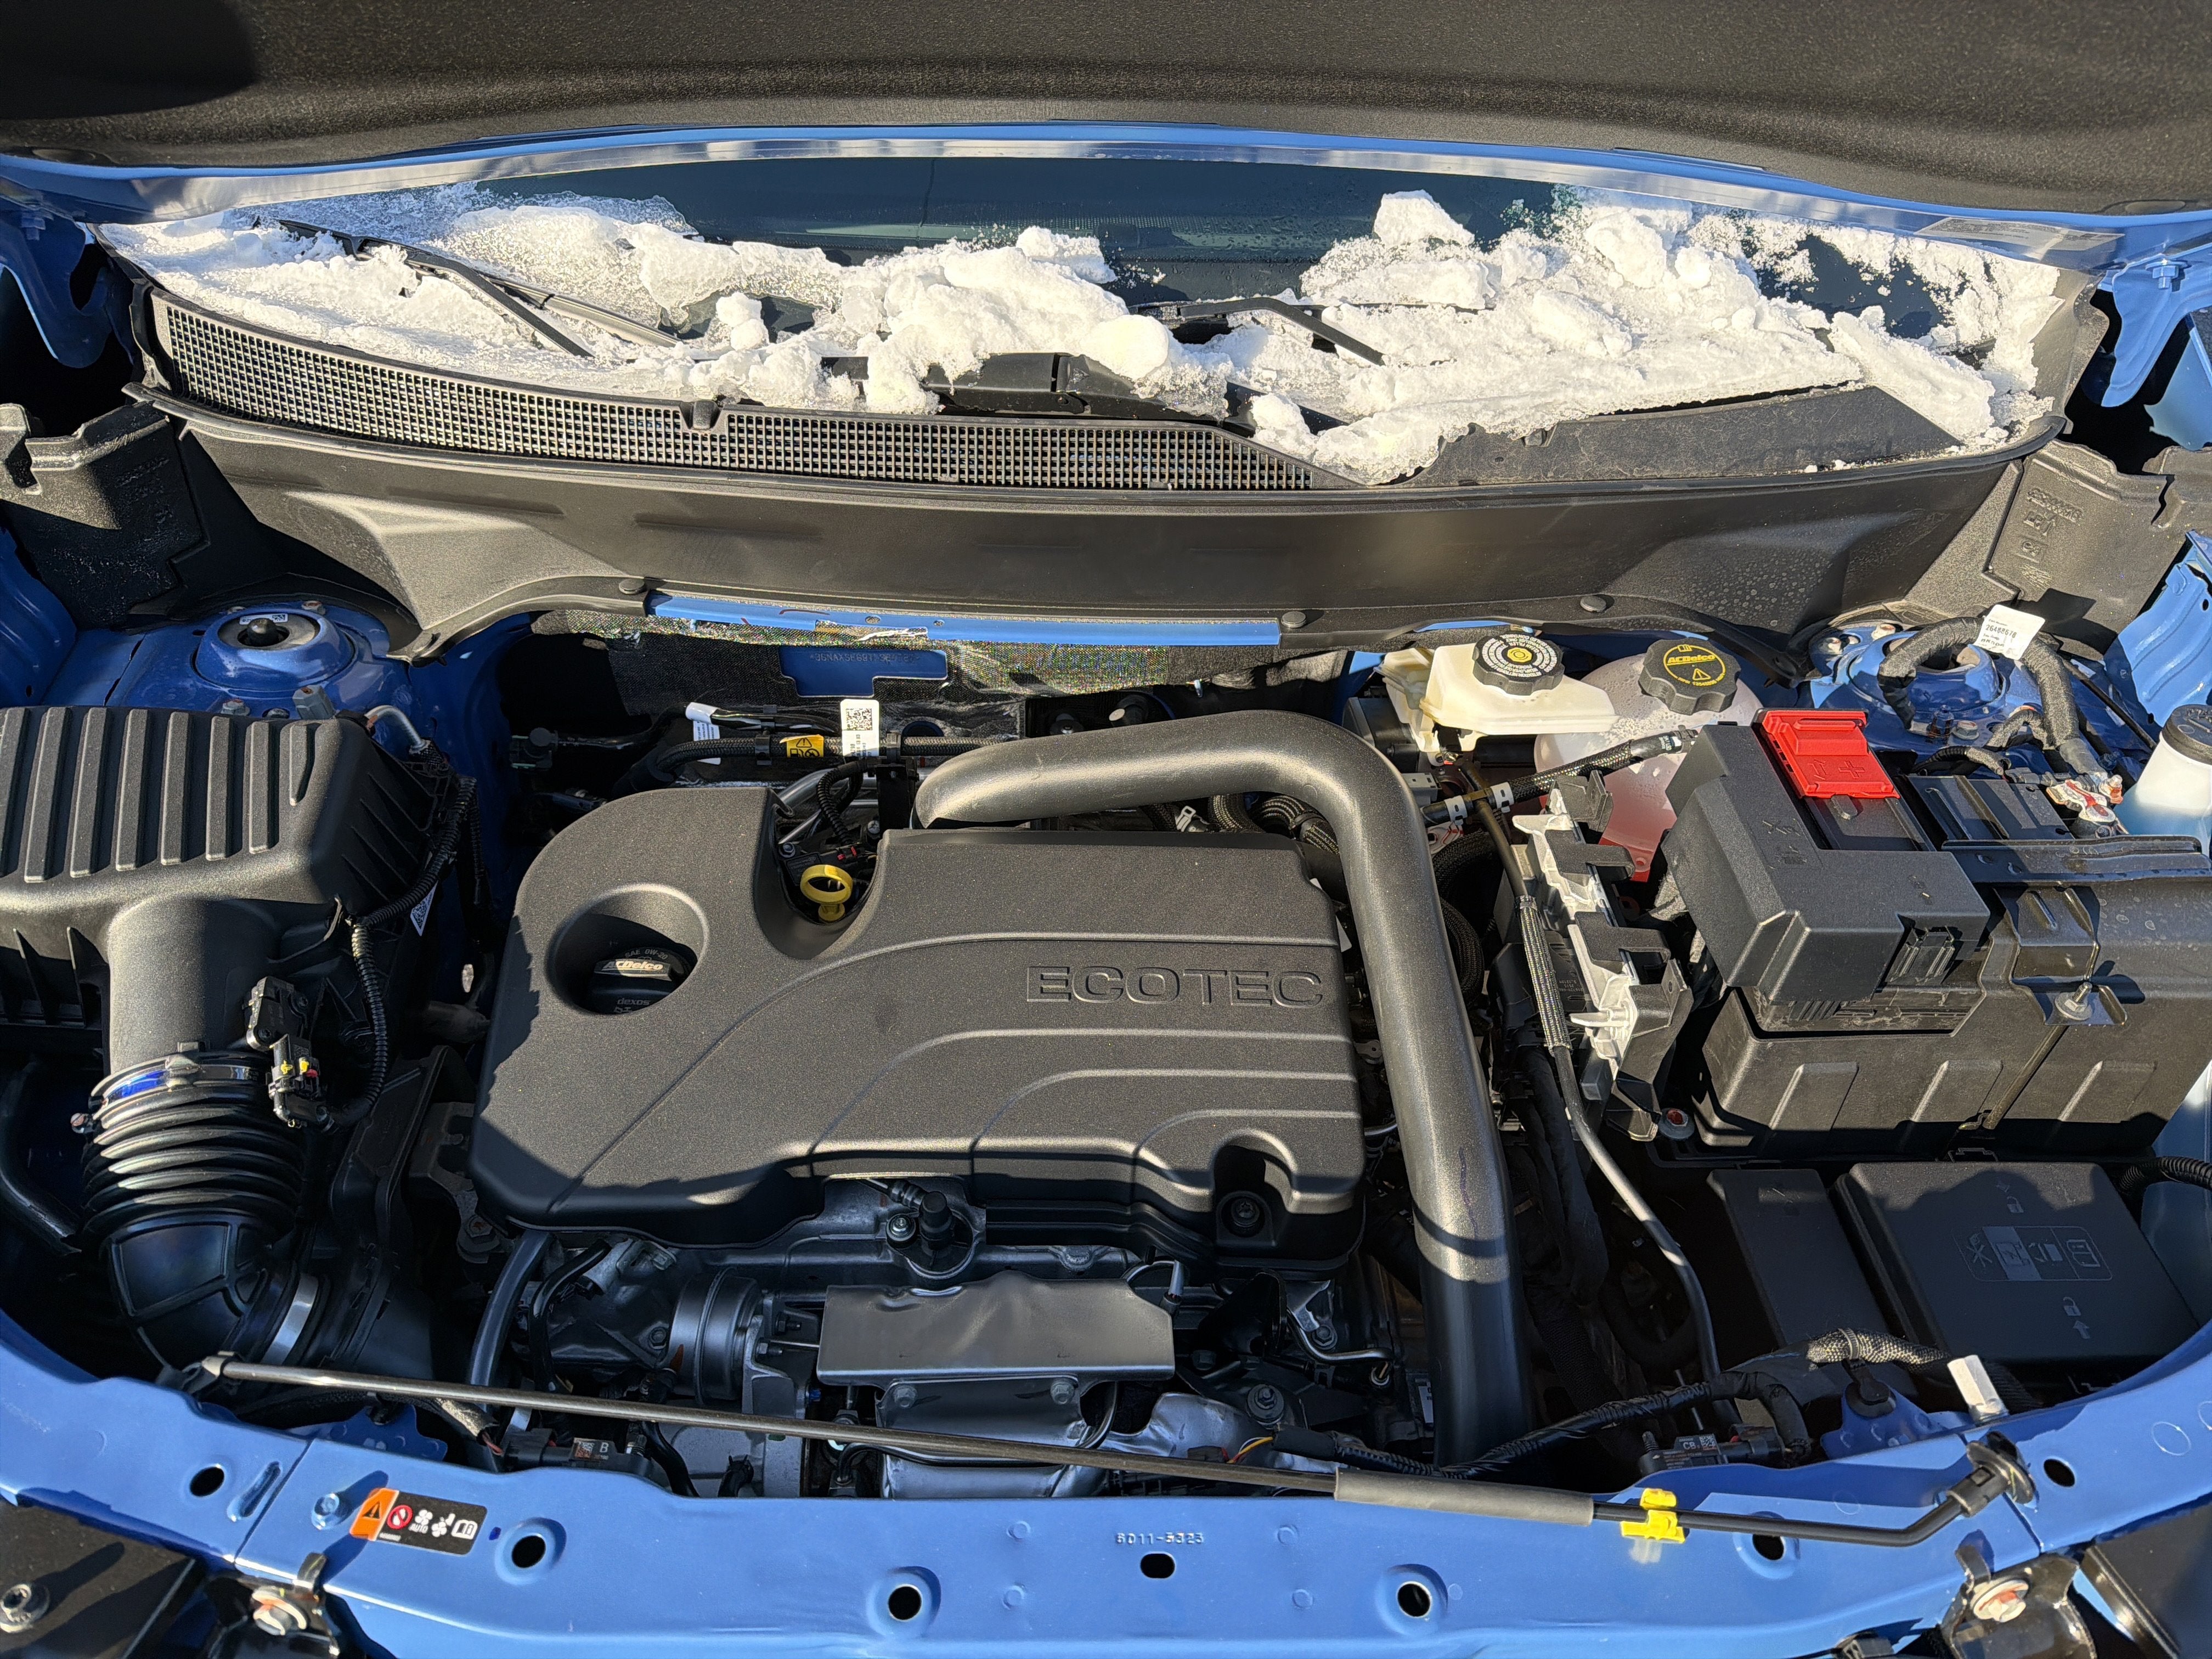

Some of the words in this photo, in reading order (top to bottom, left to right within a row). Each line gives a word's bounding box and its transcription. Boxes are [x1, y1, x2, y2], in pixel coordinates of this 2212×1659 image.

[1668, 654, 1716, 663] ACDelco
[625, 949, 641, 958] SAE
[645, 949, 669, 960] 0W-20
[602, 960, 663, 970] ACDelco
[1026, 966, 1323, 1009] ECOTEC
[617, 997, 651, 1006] dexos
[408, 1523, 428, 1534] AUTO
